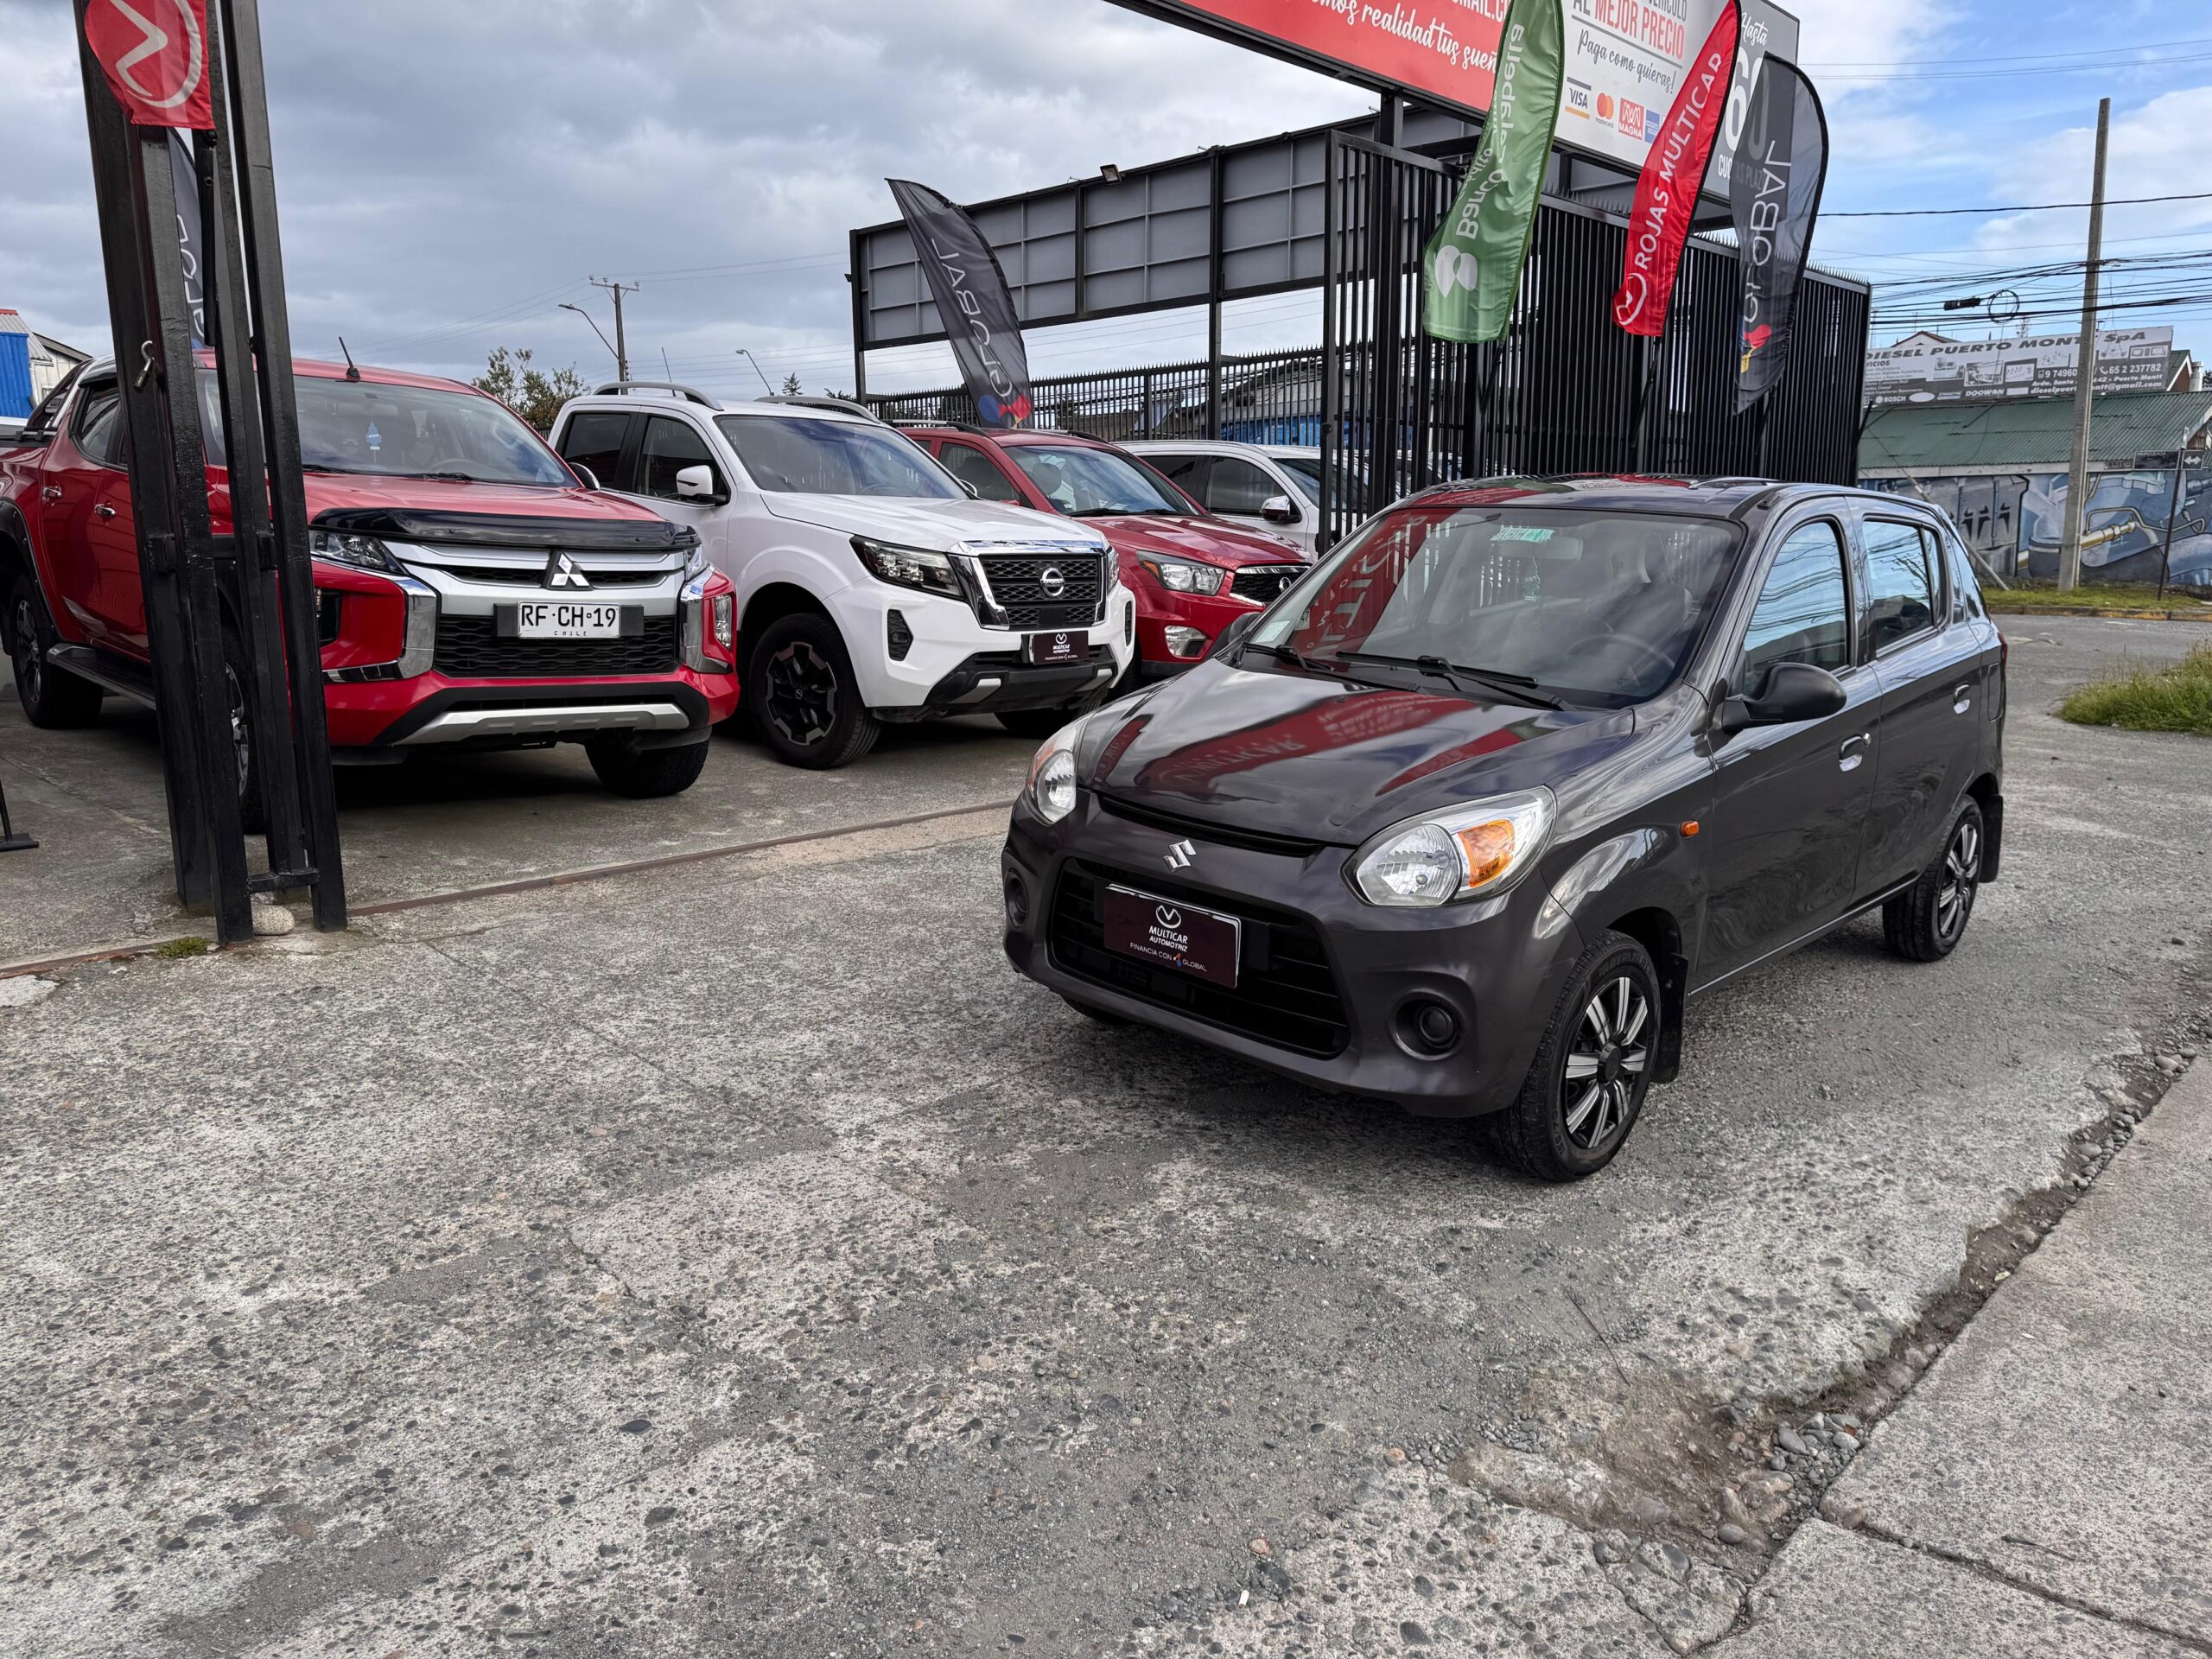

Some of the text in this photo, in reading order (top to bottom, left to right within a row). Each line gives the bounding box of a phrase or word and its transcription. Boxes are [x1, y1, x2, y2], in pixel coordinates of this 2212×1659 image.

[1361, 2, 1436, 48] realidad
[1430, 22, 1461, 66] tus
[1461, 45, 1498, 74] sueñ
[1594, 0, 1638, 38] MEJOR
[1640, 6, 1685, 60] PRECIO
[1741, 12, 1769, 46] Hasta
[1577, 28, 1677, 94] Paga como quieras!
[1568, 87, 1588, 109] VISA
[1618, 121, 1643, 138] MAGNA
[1634, 53, 1722, 270] ROJAS MULTICAR
[1929, 340, 2012, 356] PUERTO
[2018, 335, 2083, 349] MONT
[2104, 331, 2145, 343] SpA
[2052, 368, 2078, 378] 74960
[2108, 365, 2120, 374] 65
[2129, 363, 2162, 373] 237782
[1965, 388, 2005, 397] DOOWAN
[1148, 925, 1188, 944] MULTICAR
[1148, 935, 1188, 952] AUTOMOTRIZ
[1129, 942, 1208, 972] FINANCIA CON GLOBAL
